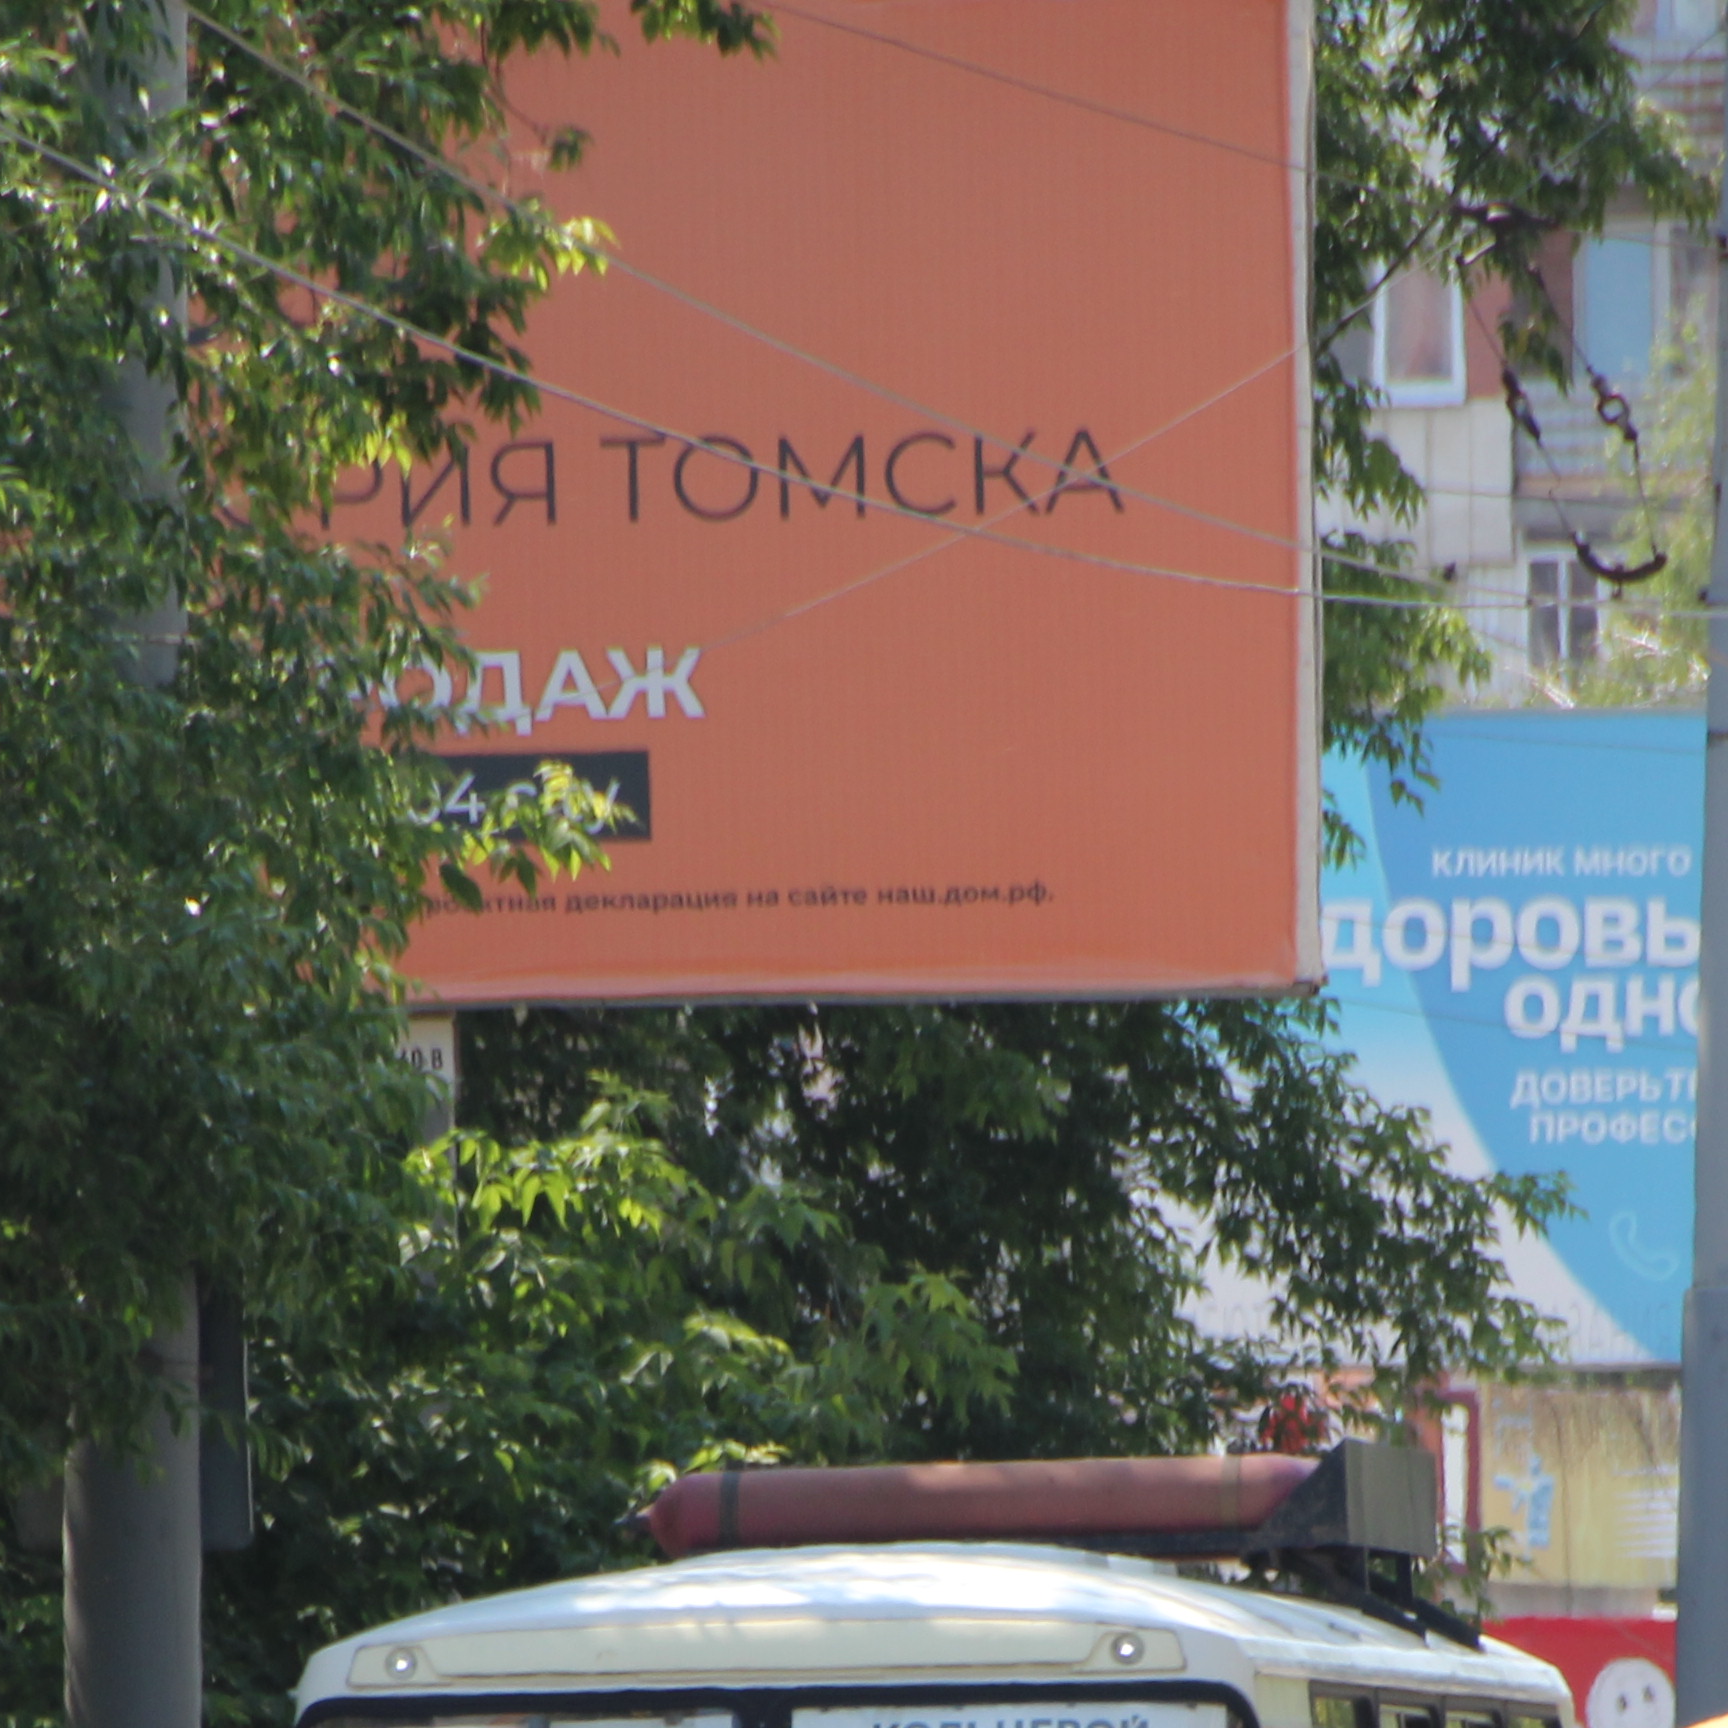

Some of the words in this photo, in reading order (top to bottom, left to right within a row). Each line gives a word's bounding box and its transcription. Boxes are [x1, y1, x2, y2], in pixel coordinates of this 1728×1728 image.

[599, 428, 1126, 523] ТОМСКА
[346, 645, 706, 736] ОДАЖ
[1431, 847, 1564, 878] КЛИНИК
[1574, 847, 1692, 876] МНОГО
[564, 887, 738, 917] декларация
[747, 888, 780, 909] на
[788, 882, 868, 907] сайте
[1321, 897, 1701, 992] доровь
[1509, 1068, 1699, 1109] ДОВЕРЬТ
